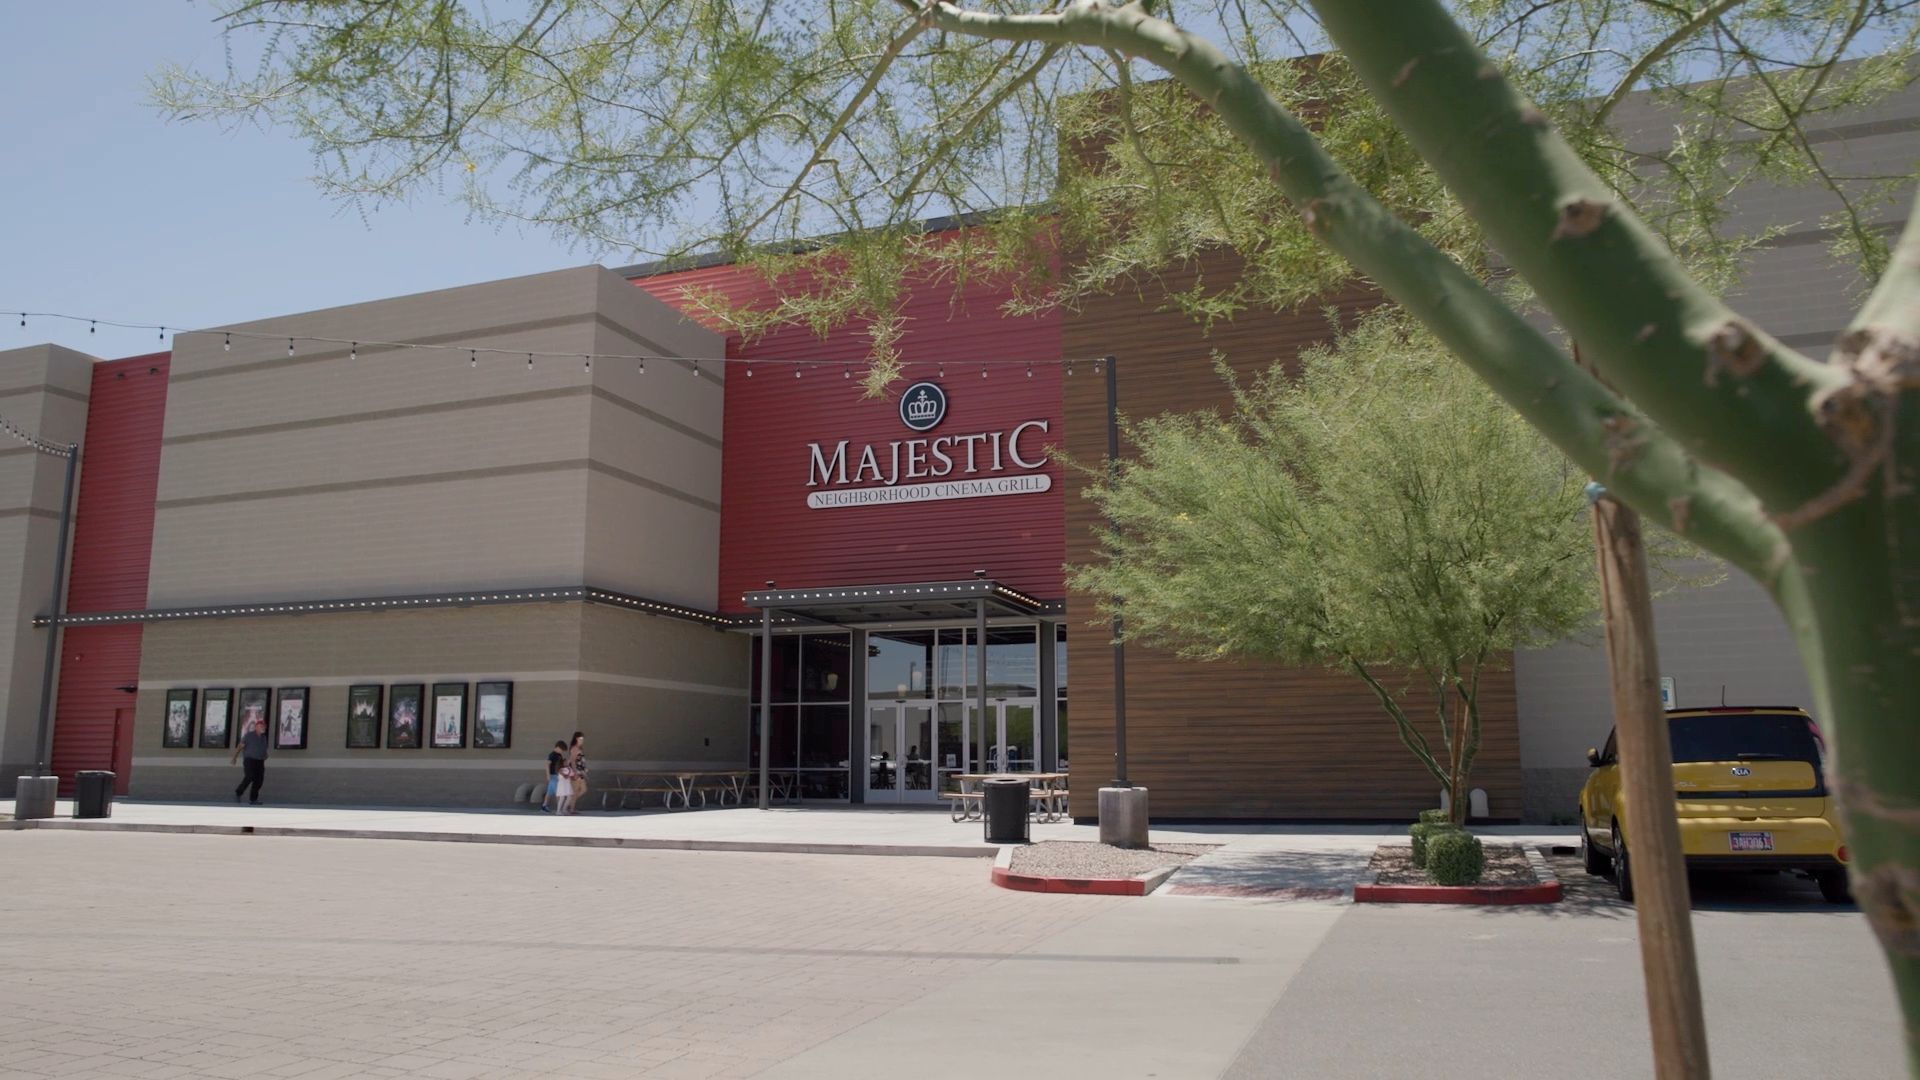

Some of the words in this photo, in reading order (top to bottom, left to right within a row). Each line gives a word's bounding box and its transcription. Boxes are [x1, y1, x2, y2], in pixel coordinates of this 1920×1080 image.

[806, 420, 1049, 486] MAJESTIC
[815, 485, 931, 506] NEIGHBORHOOD
[935, 480, 994, 498] CINEMA
[998, 476, 1044, 492] GRILL
